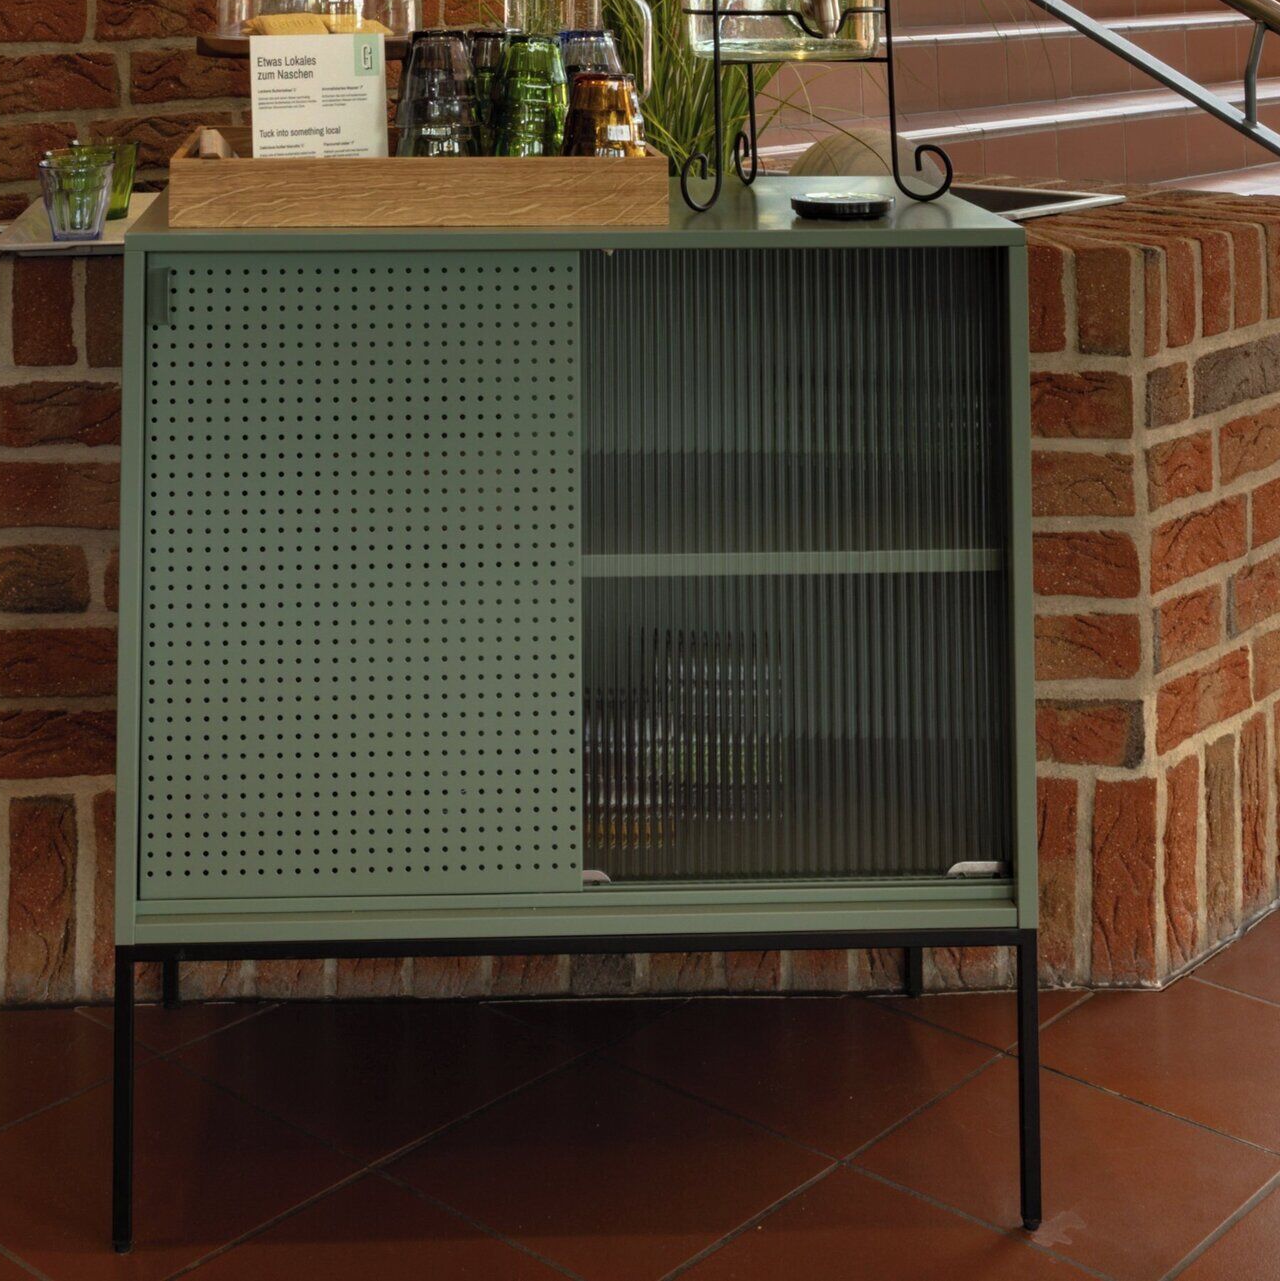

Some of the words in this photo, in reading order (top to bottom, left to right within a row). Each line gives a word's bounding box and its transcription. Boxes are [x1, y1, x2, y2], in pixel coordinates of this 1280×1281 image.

[257, 56, 282, 67] Etwas
[285, 56, 317, 66] Lokales
[258, 72, 275, 80] zum
[277, 69, 314, 79] Naschen
[260, 129, 275, 138] Tuck
[277, 128, 289, 137] into
[290, 126, 324, 138] something
[326, 126, 341, 135] local
